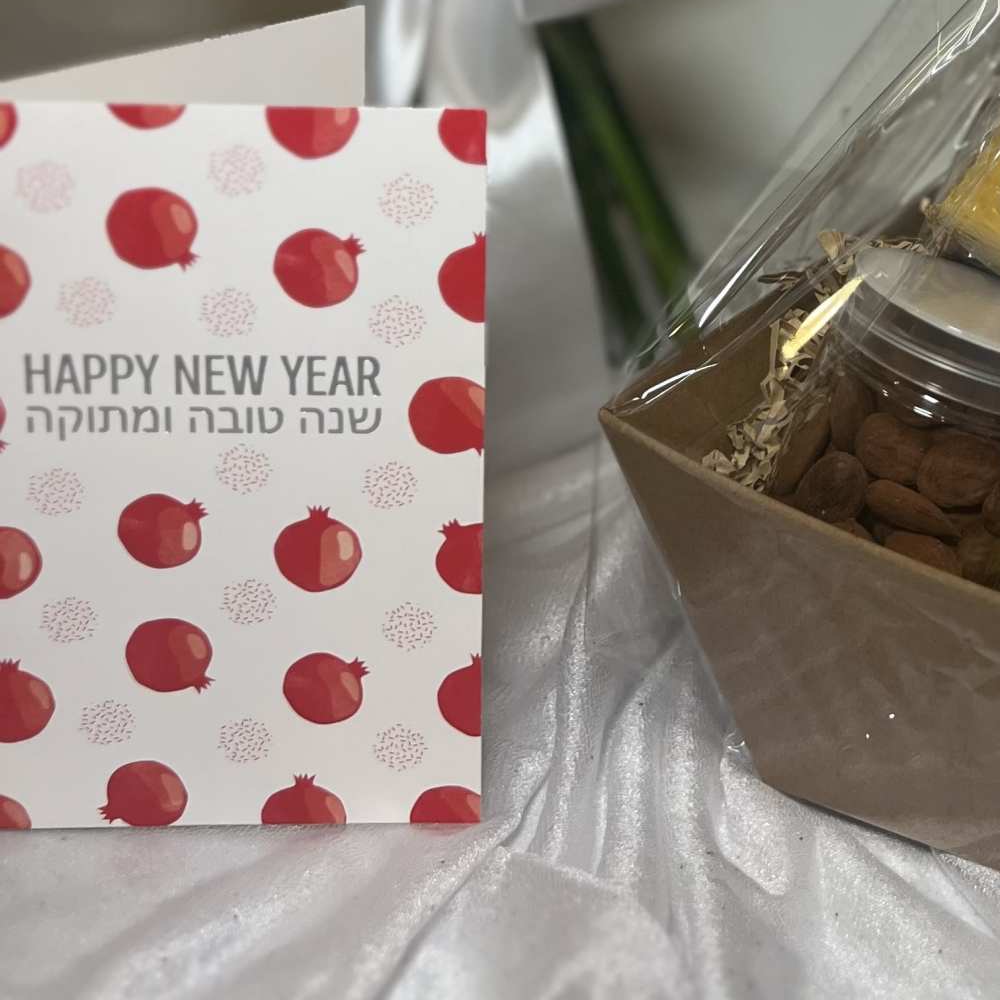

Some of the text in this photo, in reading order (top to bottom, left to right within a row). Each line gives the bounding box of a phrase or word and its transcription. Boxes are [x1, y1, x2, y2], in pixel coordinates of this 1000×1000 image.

[23, 353, 383, 397] HAPPY NEW YEAR
[25, 405, 382, 442] שנה טובה ומתוקה
